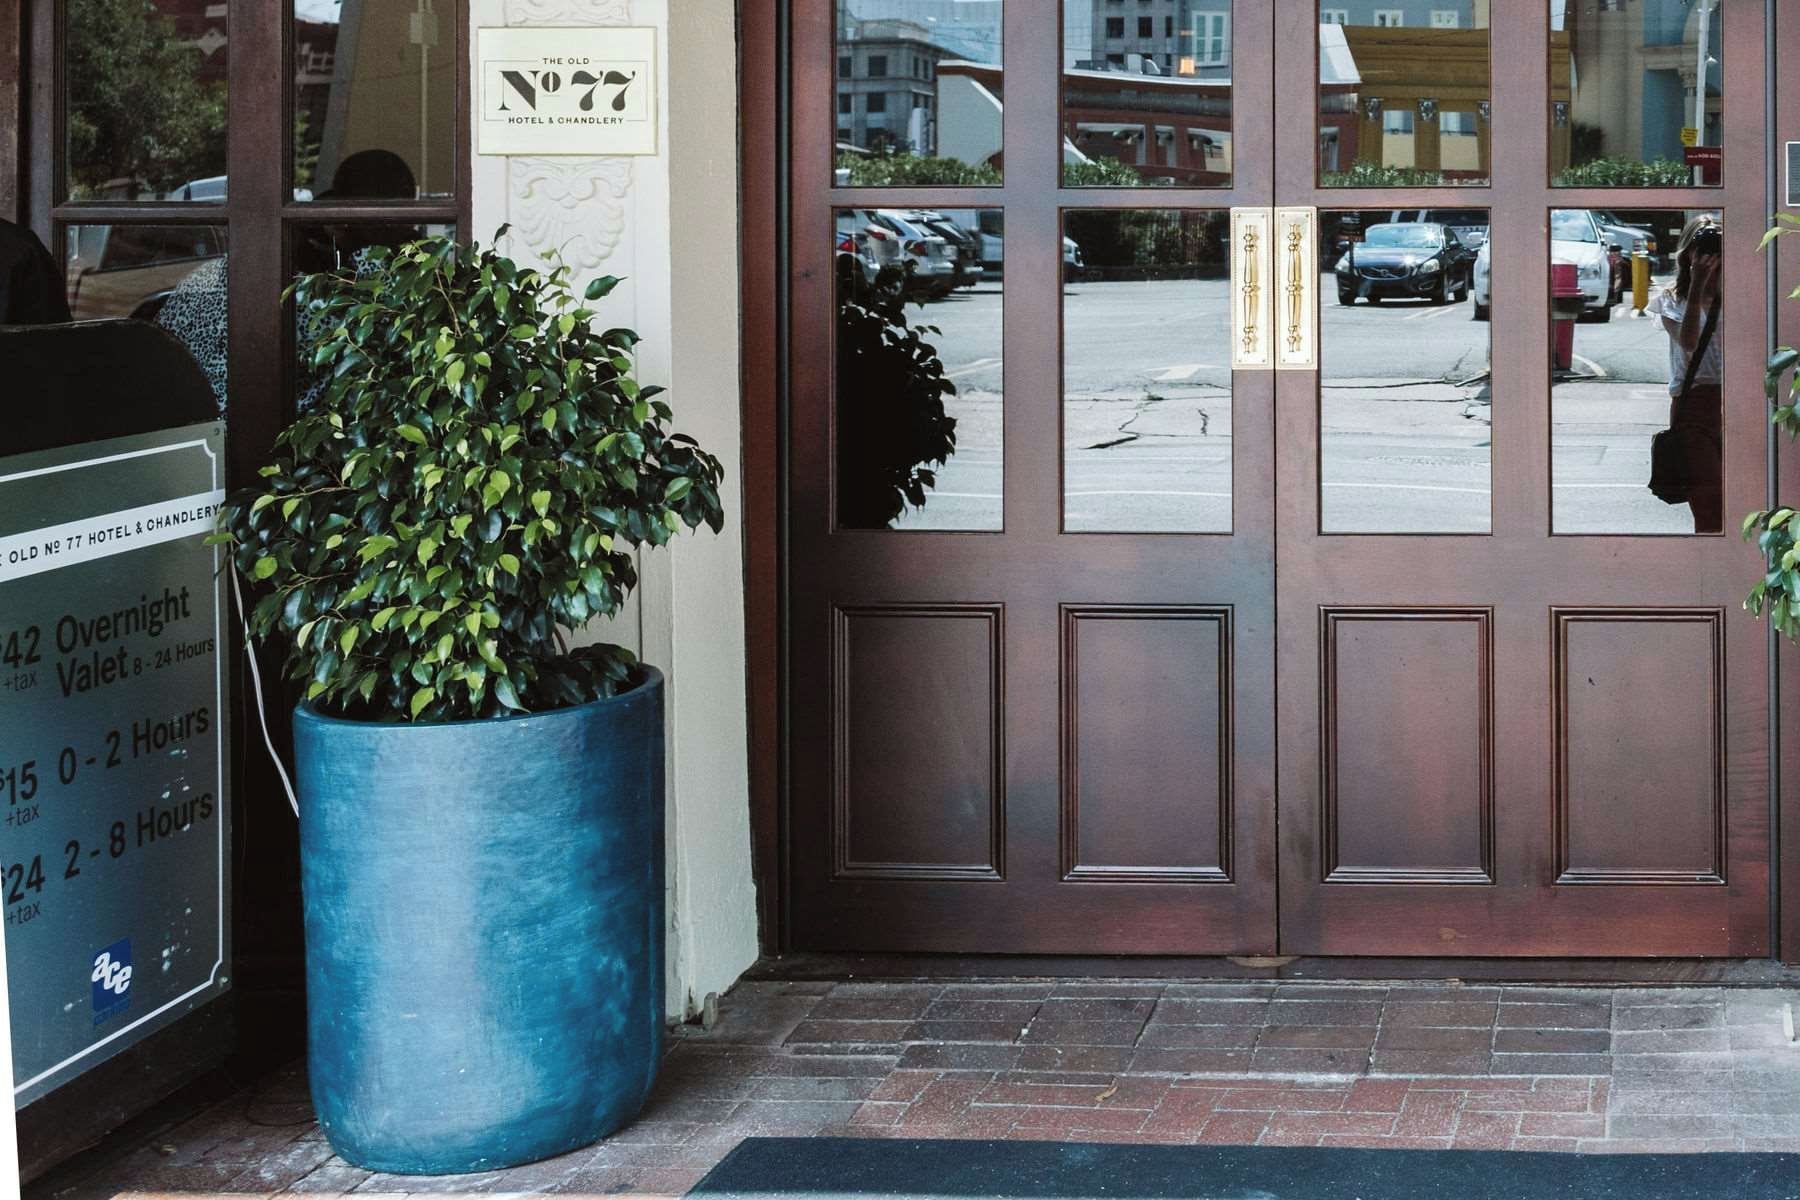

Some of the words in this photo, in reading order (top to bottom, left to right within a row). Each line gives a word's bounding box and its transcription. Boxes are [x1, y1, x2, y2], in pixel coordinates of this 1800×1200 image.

[571, 70, 636, 111] 77
[557, 117, 624, 125] CHANDLERY
[9, 546, 38, 564] OLD
[67, 535, 82, 550] 77
[89, 526, 131, 545] HOTEL
[135, 521, 143, 535] &
[146, 504, 219, 532] CHANDLERY
[0, 626, 41, 668] 42
[56, 586, 190, 653] Overnight
[4, 670, 38, 692] +tax
[56, 646, 128, 697] Valet
[133, 657, 142, 676] 8
[155, 650, 172, 670] 24
[176, 637, 214, 664] Hours
[59, 747, 77, 785] 0
[106, 730, 121, 769] 2
[132, 707, 209, 759] Hours
[6, 803, 40, 827] +tax
[64, 840, 80, 880] 2
[110, 821, 125, 858] 8
[137, 793, 213, 847] Hours
[7, 901, 41, 925] +tax
[91, 952, 132, 994] ace
